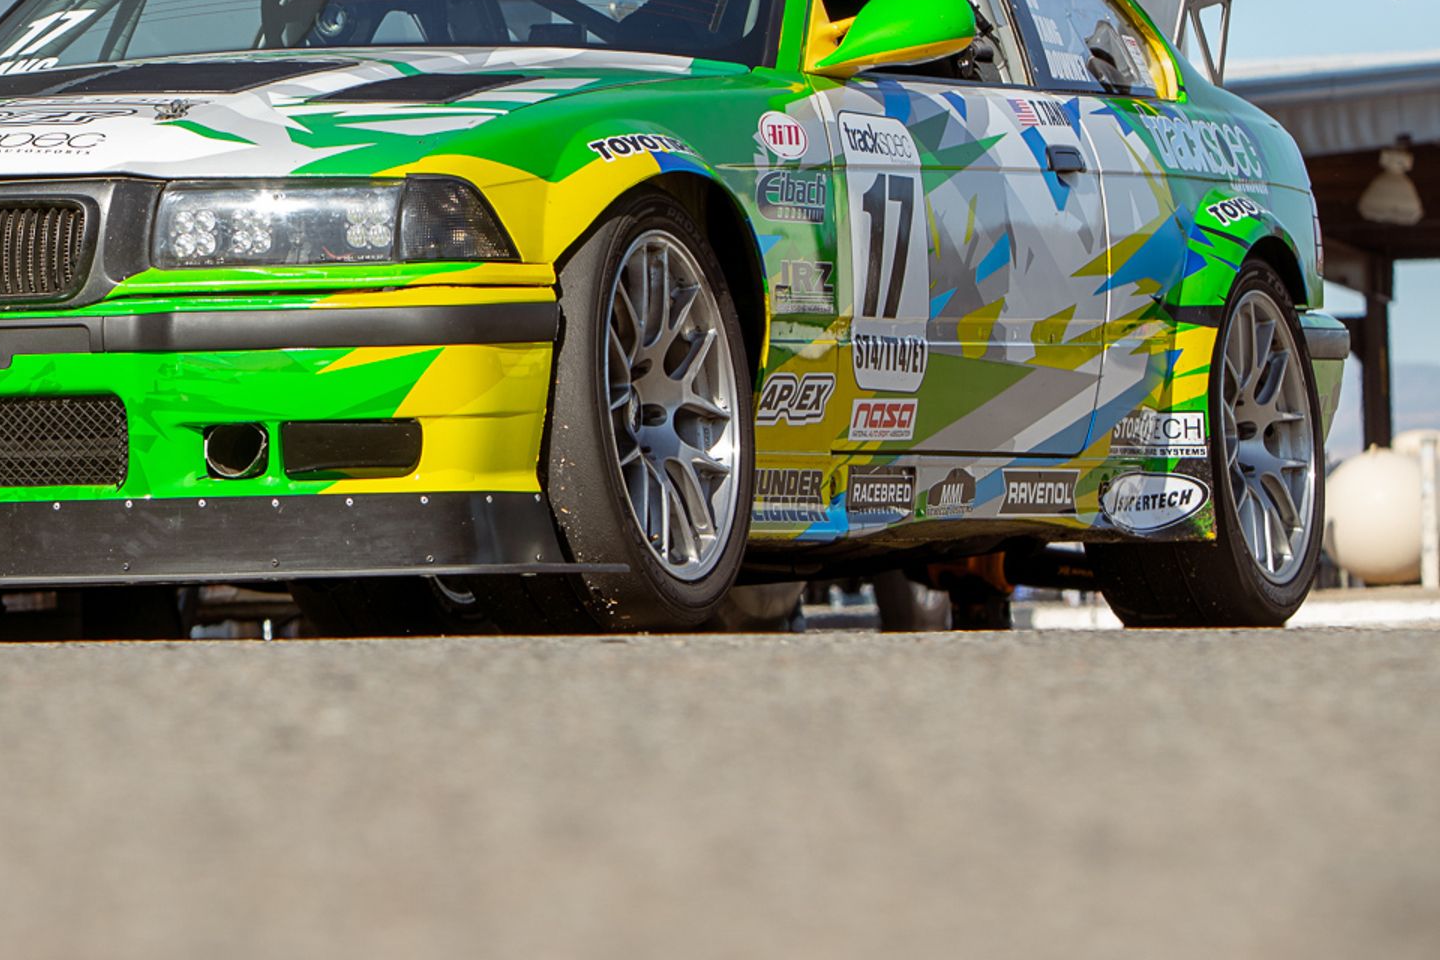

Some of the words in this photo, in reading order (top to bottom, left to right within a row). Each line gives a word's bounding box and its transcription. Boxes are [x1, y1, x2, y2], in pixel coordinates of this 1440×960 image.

[589, 134, 662, 160] TOYO
[842, 121, 913, 162] trackspec
[756, 170, 827, 217] Eibach
[862, 173, 915, 319] 17
[852, 483, 911, 503] RACEBRED
[1007, 481, 1072, 505] RAVENOL
